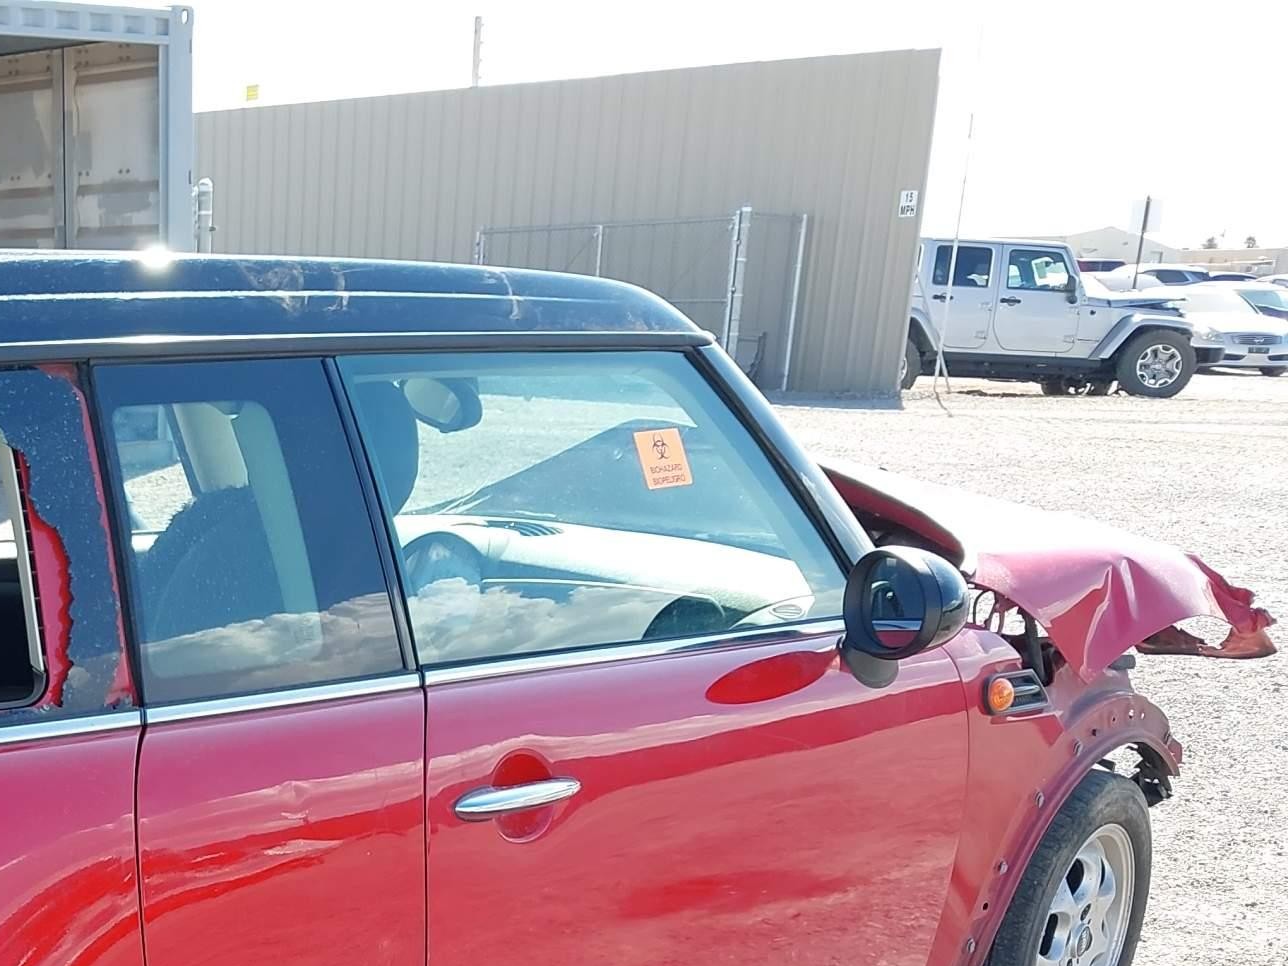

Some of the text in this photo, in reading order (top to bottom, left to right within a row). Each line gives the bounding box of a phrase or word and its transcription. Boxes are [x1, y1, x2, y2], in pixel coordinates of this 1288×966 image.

[905, 191, 914, 203] 15
[900, 204, 915, 215] MPH
[649, 463, 683, 474] BIOHAZARD
